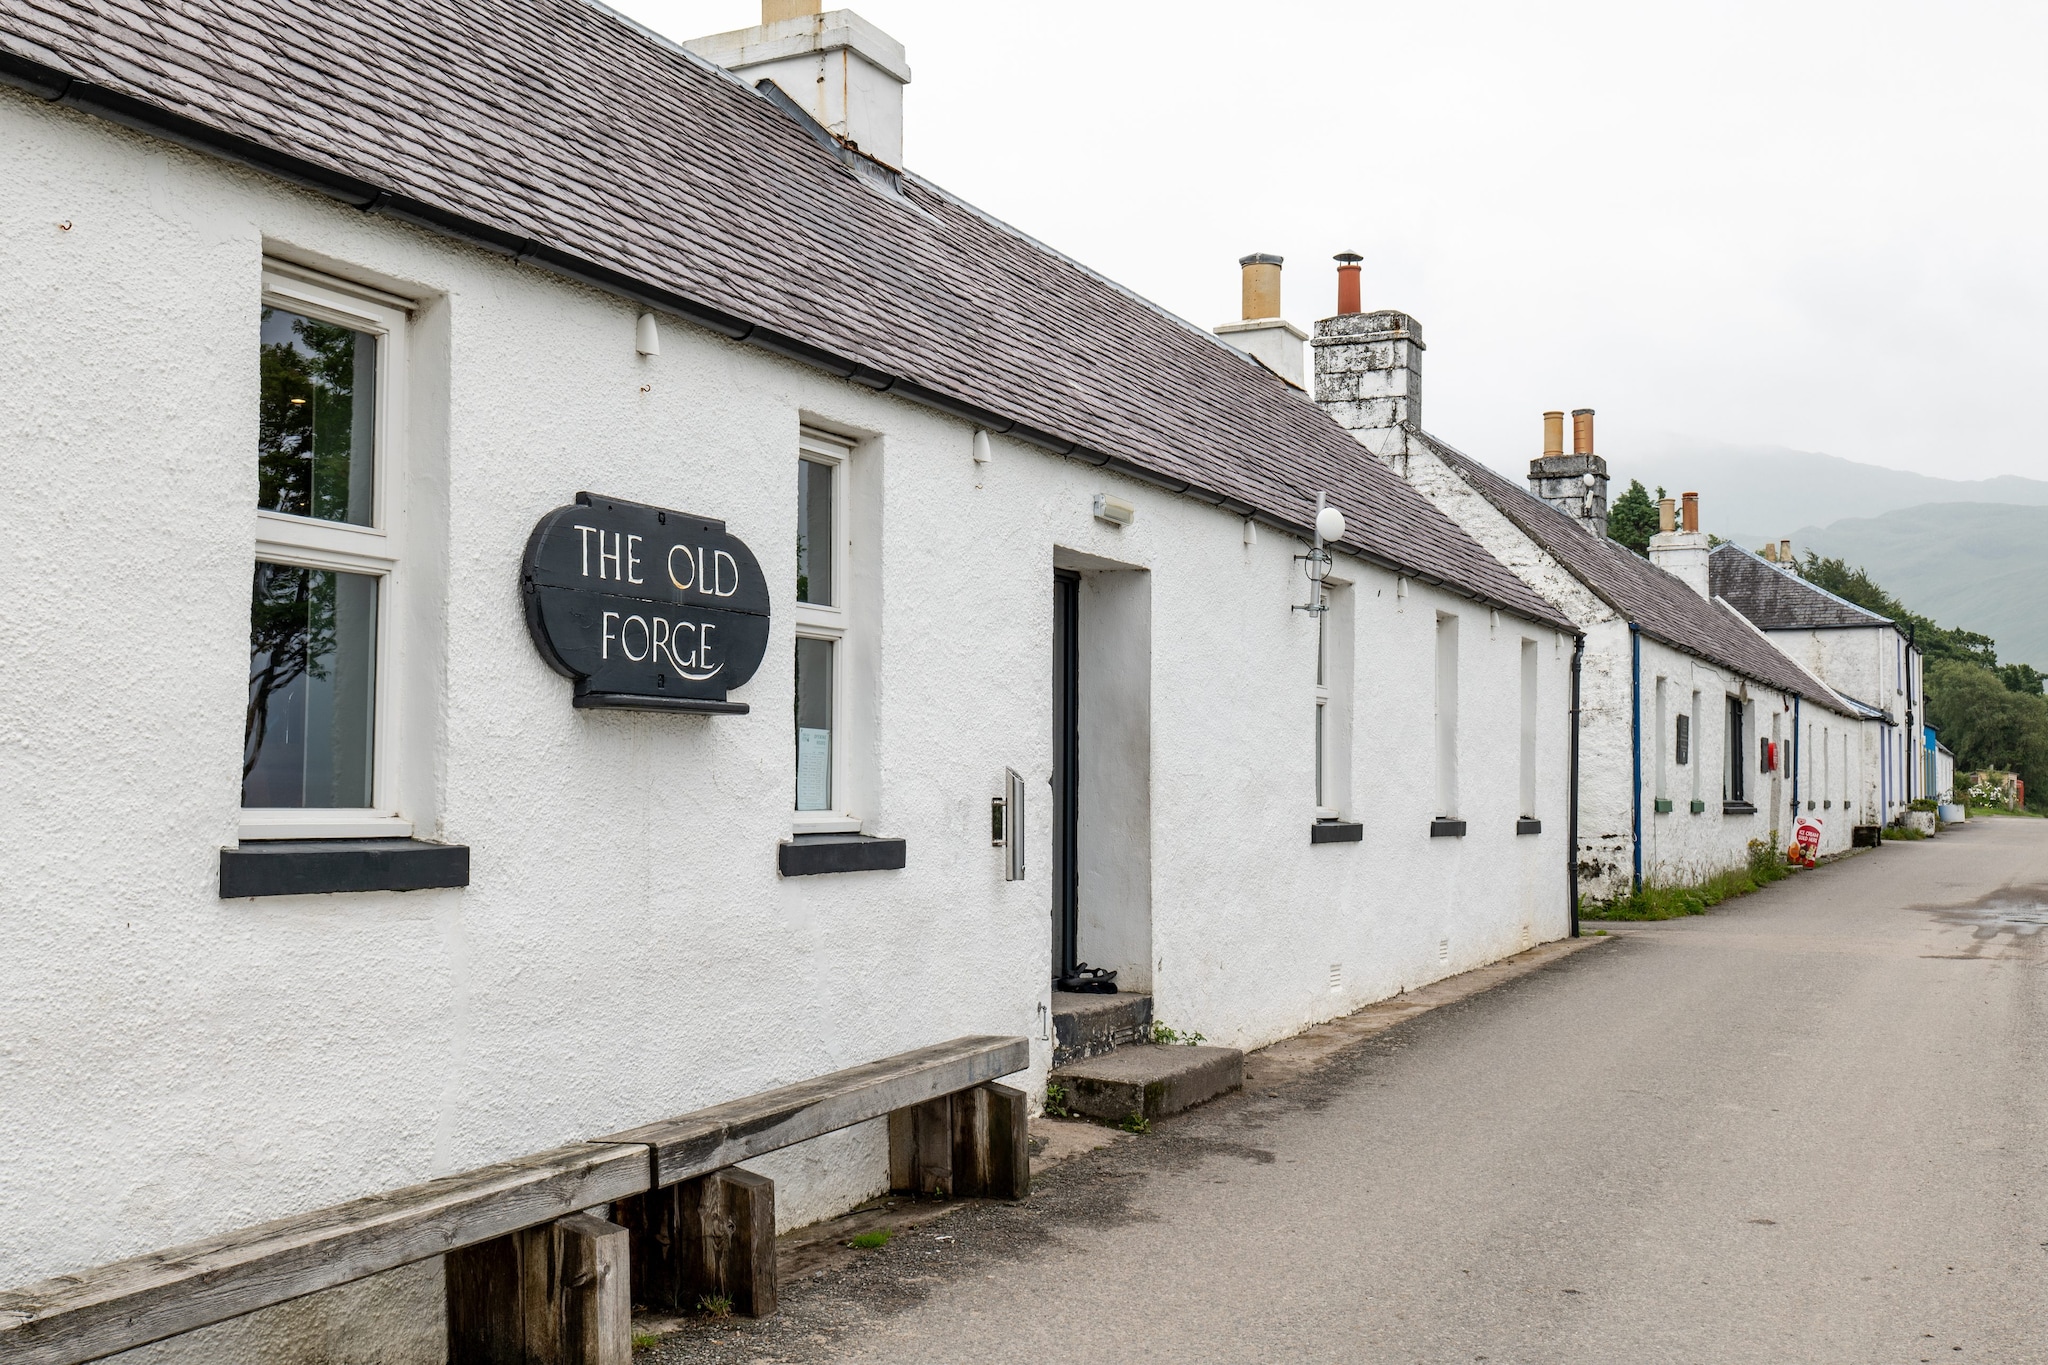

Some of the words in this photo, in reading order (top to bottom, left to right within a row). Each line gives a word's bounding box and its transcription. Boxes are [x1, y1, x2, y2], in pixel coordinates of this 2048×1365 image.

[574, 525, 643, 585] THE
[667, 544, 739, 597] OLD
[602, 611, 724, 681] FORGE
